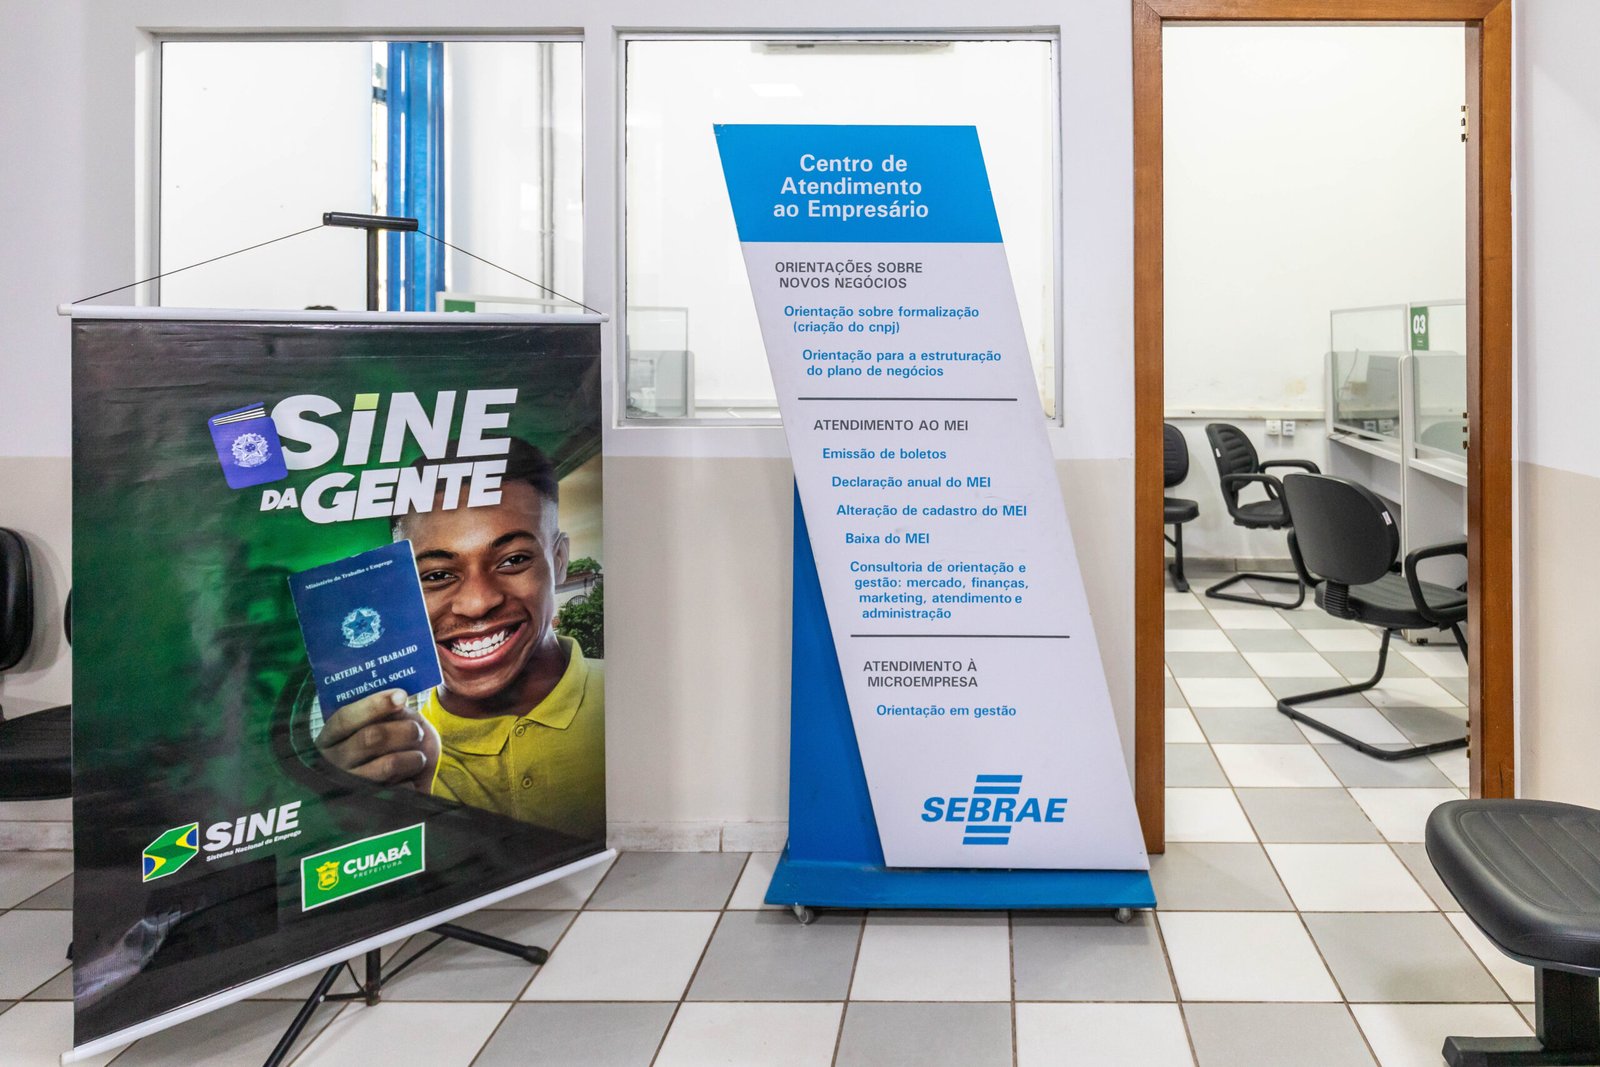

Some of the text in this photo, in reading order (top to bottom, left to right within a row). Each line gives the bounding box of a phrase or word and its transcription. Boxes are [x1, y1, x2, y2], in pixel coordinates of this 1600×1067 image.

[799, 153, 908, 173] Centro de
[780, 176, 922, 195] Atendimento
[773, 199, 929, 222] ao Empresário
[774, 259, 923, 277] ORIENTAÇÕES SOBRE
[779, 274, 907, 289] NOVOS NEGÓCIOS
[783, 305, 980, 320] Orientação sobre formalização
[793, 320, 900, 335] (criação do cnpj)
[1413, 314, 1426, 335] 03
[802, 348, 1002, 367] Orientação para a estruturação
[806, 364, 944, 379] do plano de negócios
[813, 419, 969, 431] ATENDIMENTO AO MEI
[822, 447, 947, 460] Emissão de boletos
[831, 475, 991, 490] Declaração anual do MEI
[259, 459, 508, 525] DA GENTE
[836, 504, 1027, 519] Alteração de cadastro do MEI
[845, 532, 930, 545] Baixa do MEI
[341, 567, 366, 579] Trabalho
[849, 560, 1027, 576] Consultoria de orientação e
[854, 576, 1029, 591] gestão: mercado, finanças,
[858, 591, 1023, 606] marketing, atendimento e
[861, 607, 952, 622] administração
[324, 644, 419, 685] CARTEIRA DE TRABALHO
[863, 657, 978, 672] ATENDIMENTO À
[371, 669, 378, 679] E
[336, 666, 417, 703] PREVIDÊNCIA SOCIAL
[867, 676, 978, 688] MICROEMPRESA
[876, 704, 1017, 719] Orientação em gestão
[920, 796, 1068, 823] SEBRAE
[206, 850, 235, 862] Sistema
[235, 840, 265, 854] Nacional
[273, 830, 302, 843] Emprego
[343, 840, 412, 875] CUIABÁ
[353, 860, 403, 879] PREFEITURA
